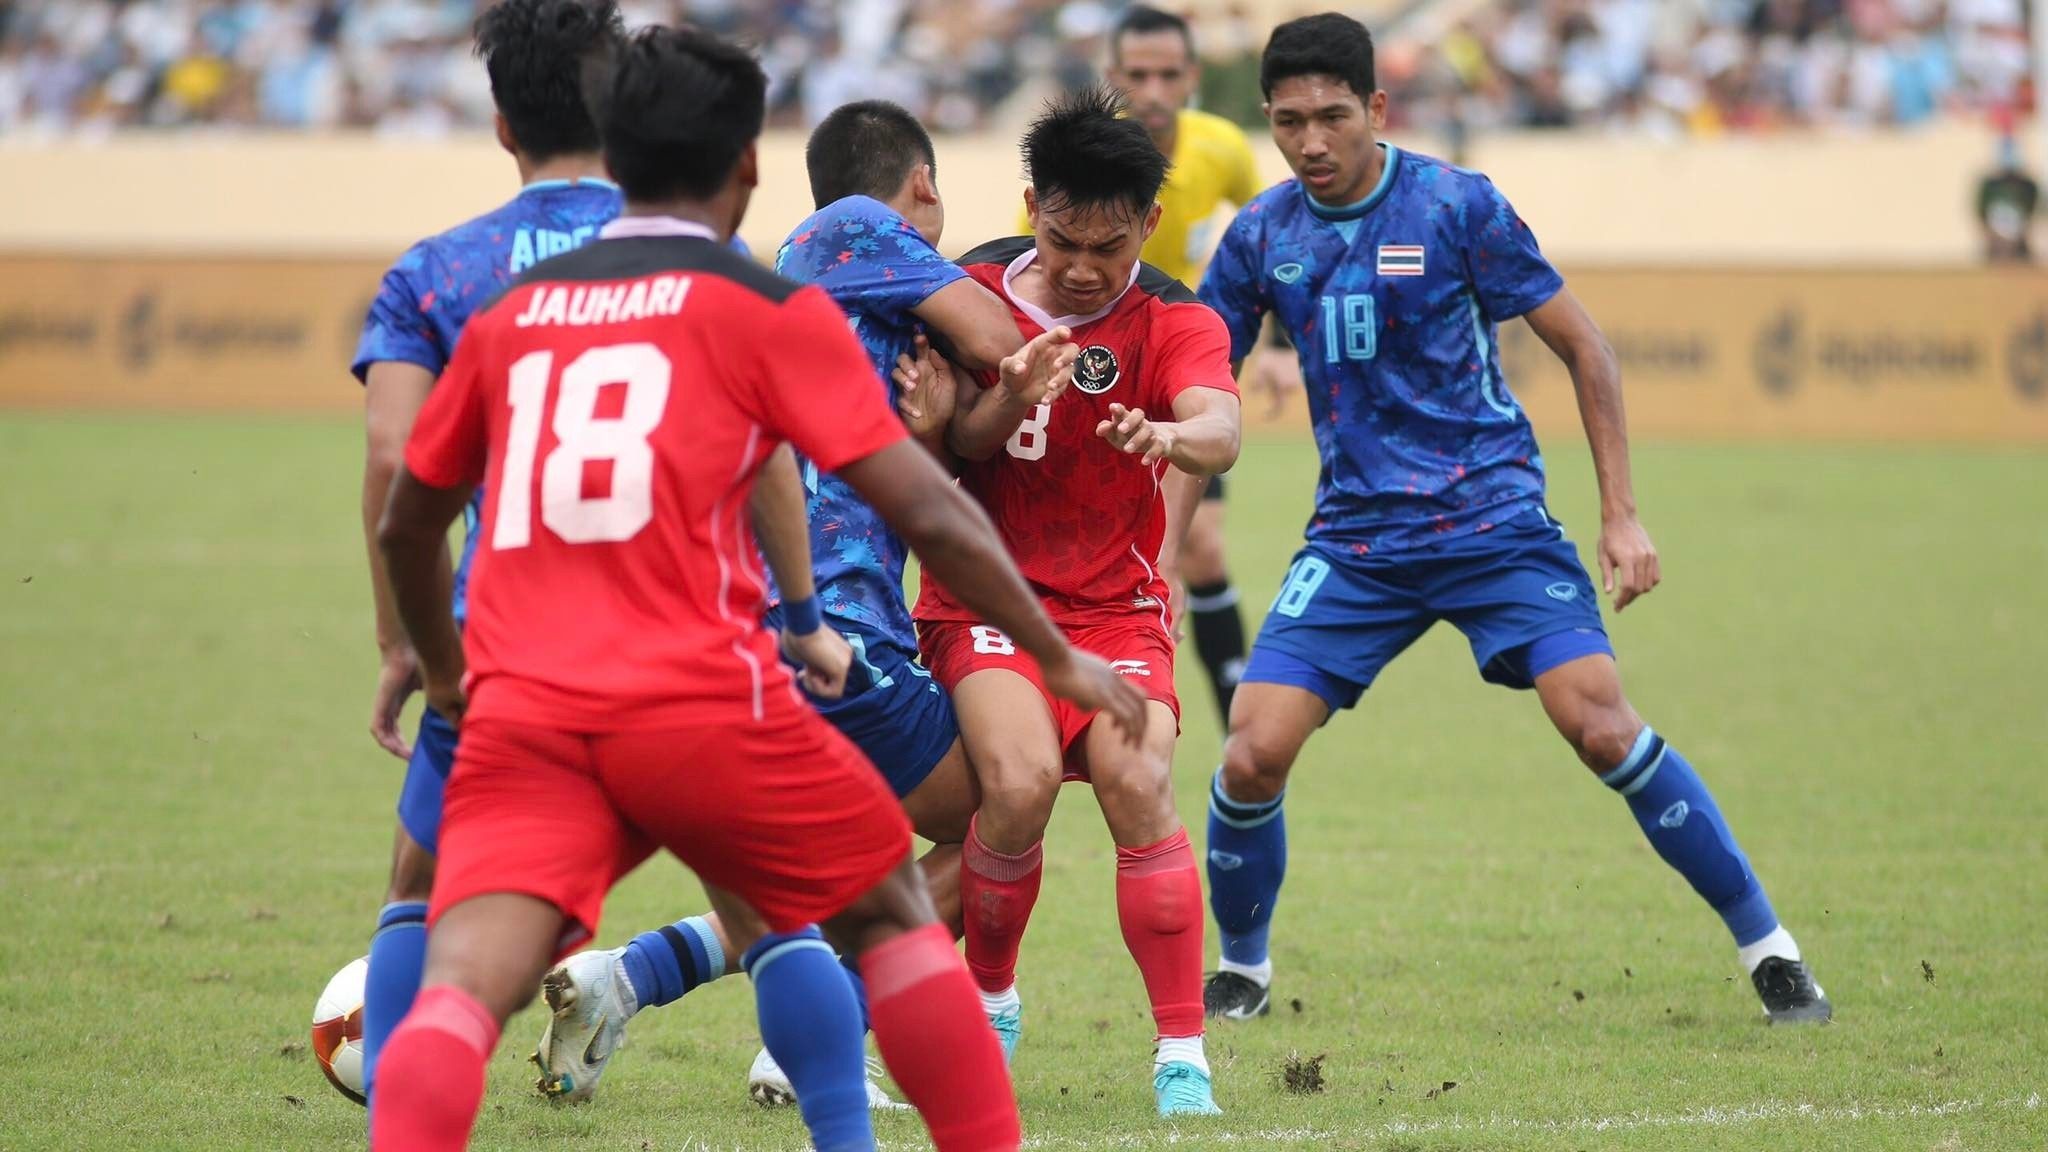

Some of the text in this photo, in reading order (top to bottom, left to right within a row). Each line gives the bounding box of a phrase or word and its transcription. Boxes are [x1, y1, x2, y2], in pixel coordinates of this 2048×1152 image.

[515, 276, 692, 328] JAUHARI
[1321, 294, 1376, 363] 18
[492, 342, 672, 550] 18
[1006, 403, 1051, 461] 8
[970, 625, 1016, 656] 8
